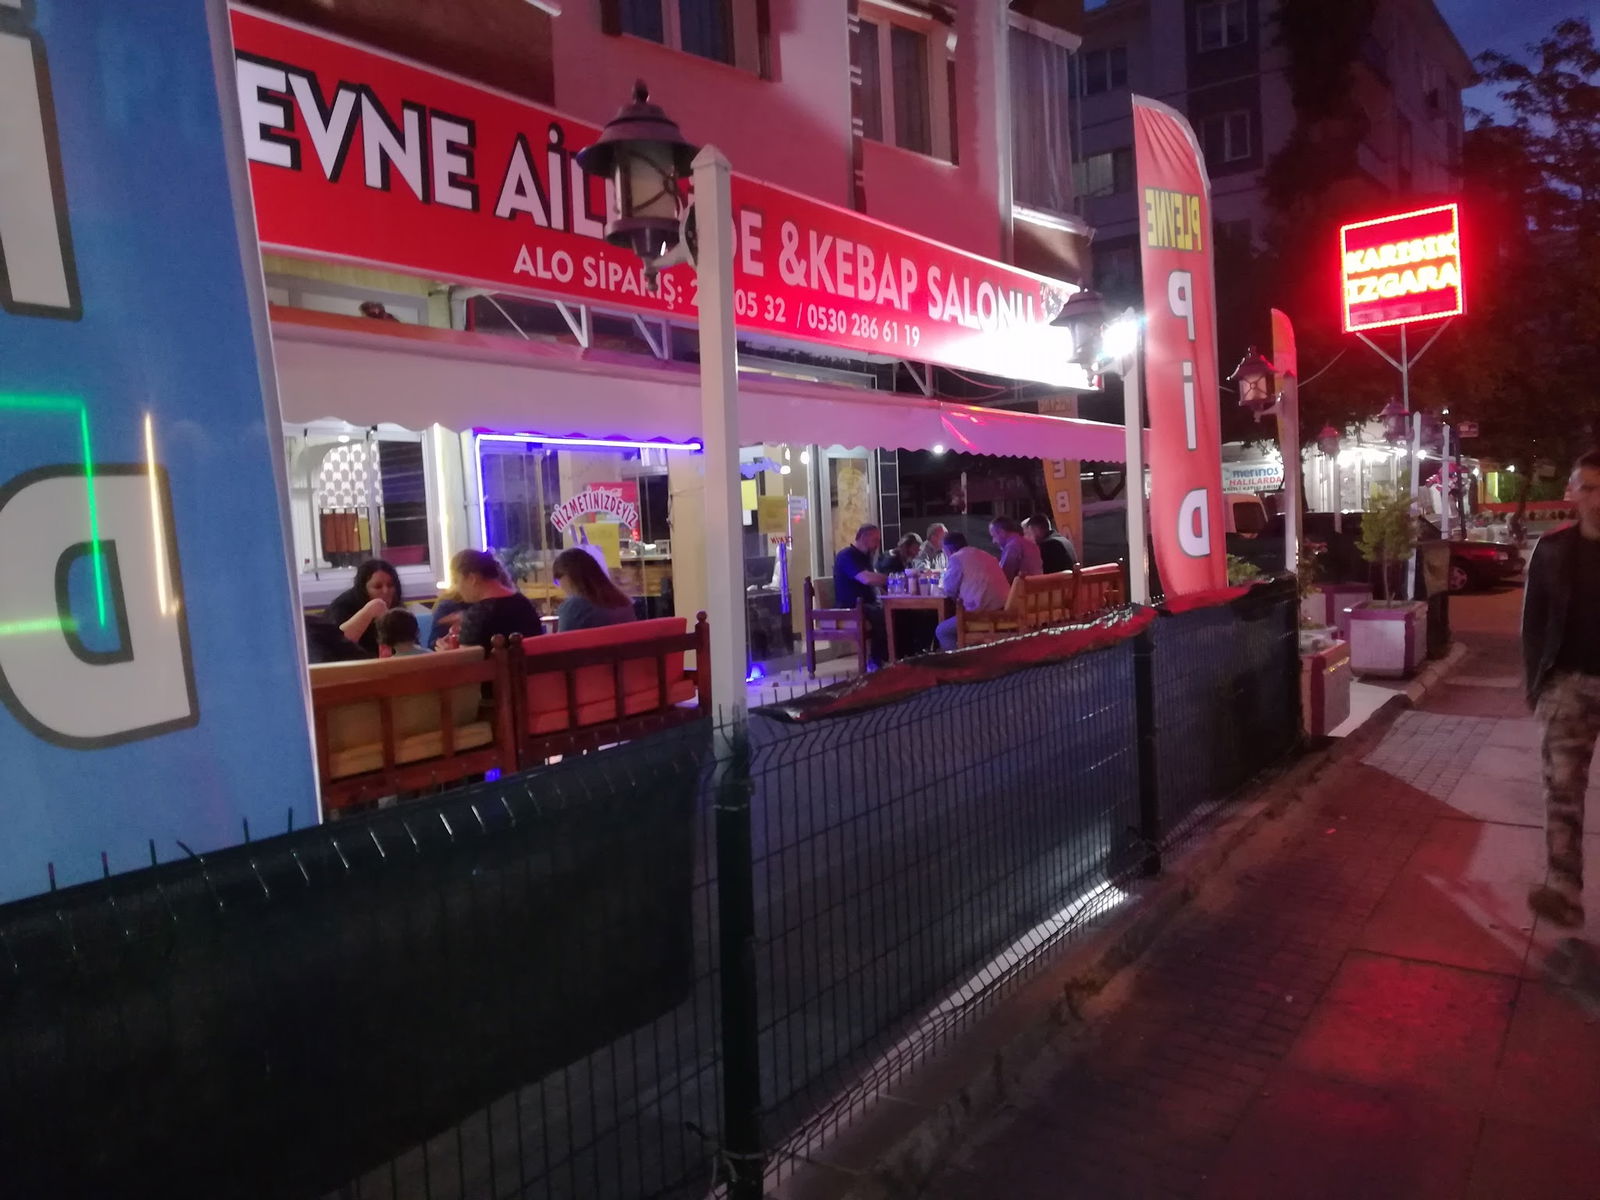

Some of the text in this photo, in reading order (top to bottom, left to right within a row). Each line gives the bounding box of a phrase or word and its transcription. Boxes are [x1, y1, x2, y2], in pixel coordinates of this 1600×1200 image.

[236, 54, 478, 212] EVNE
[513, 244, 574, 283] ALO
[735, 289, 758, 318] 05
[764, 294, 786, 323] 32
[807, 303, 847, 334] 0530
[851, 312, 879, 340] 286
[882, 320, 898, 344] 61
[904, 323, 920, 347] 19
